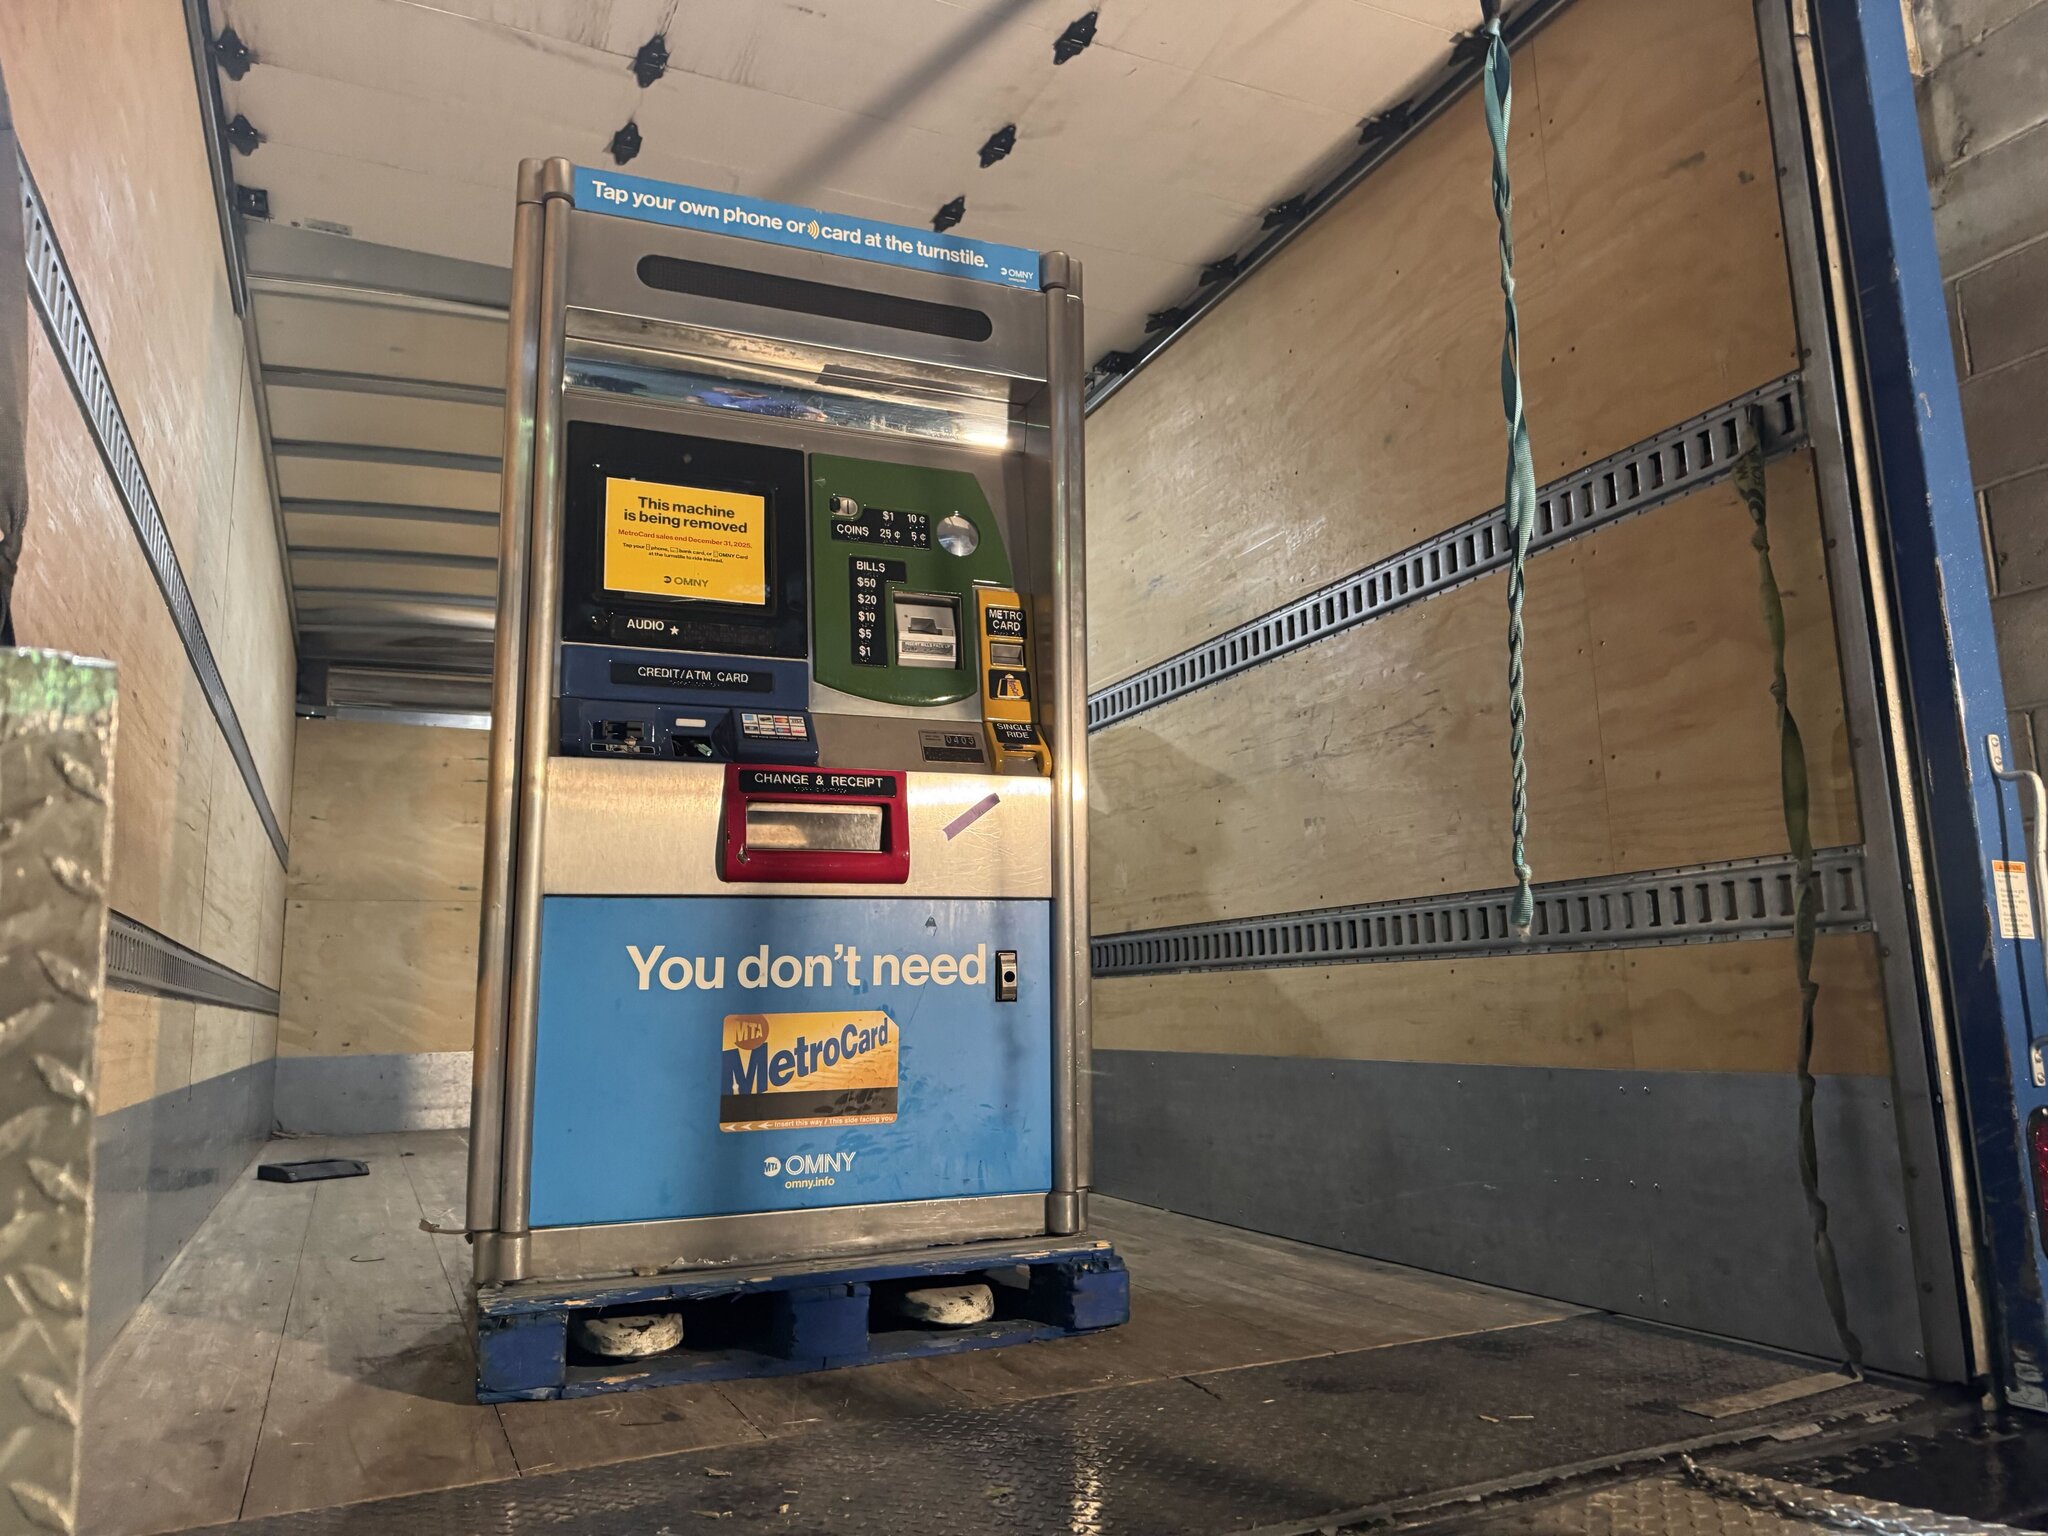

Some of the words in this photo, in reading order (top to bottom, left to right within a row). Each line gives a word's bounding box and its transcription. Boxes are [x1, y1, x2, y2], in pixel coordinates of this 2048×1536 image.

[592, 180, 628, 204] Tap
[632, 191, 676, 211] your
[679, 201, 719, 219] own
[723, 207, 782, 230] phone
[786, 220, 806, 234] or
[821, 228, 861, 244] card
[865, 232, 881, 248] at
[885, 234, 913, 253] the
[917, 241, 989, 268] turnstile.
[1008, 269, 1034, 279] OMNY
[638, 496, 670, 511] This
[672, 503, 735, 518] machine
[624, 509, 636, 520] is
[639, 511, 680, 528] being
[683, 518, 747, 533] removed
[882, 510, 894, 522] $1
[907, 514, 917, 523] 10
[919, 515, 925, 524] ¢
[836, 524, 870, 536] COINS
[880, 528, 891, 539] 25
[894, 530, 901, 540] ¢
[912, 531, 917, 541] 5
[920, 532, 926, 542] ¢
[618, 529, 655, 539] MetroCard
[688, 536, 723, 546] December
[856, 560, 886, 573] BILLS
[674, 576, 708, 588] OMNY
[857, 576, 876, 588] $50
[858, 594, 877, 605] $20
[858, 611, 876, 622] $10
[988, 609, 1024, 621] METRO
[627, 618, 664, 630] AUDIO
[992, 620, 1021, 632] CARD
[858, 628, 872, 639] $5
[859, 645, 871, 657] $1
[638, 666, 711, 681] CREDIT/ATM
[717, 671, 749, 684] CARD
[996, 723, 1032, 732] SINGLE
[1006, 731, 1030, 739] RIDE
[754, 773, 809, 786] CHANGE
[816, 775, 824, 786] &
[831, 776, 883, 788] RECEIPT
[627, 944, 725, 990] You
[738, 944, 861, 988] don’t
[873, 944, 987, 986] need
[735, 1021, 762, 1042] MTA
[722, 1017, 888, 1095] MetroCard
[829, 1117, 844, 1125] This
[859, 1116, 880, 1124] facing
[785, 1152, 856, 1176] OMNY
[785, 1177, 835, 1190] omny.info
